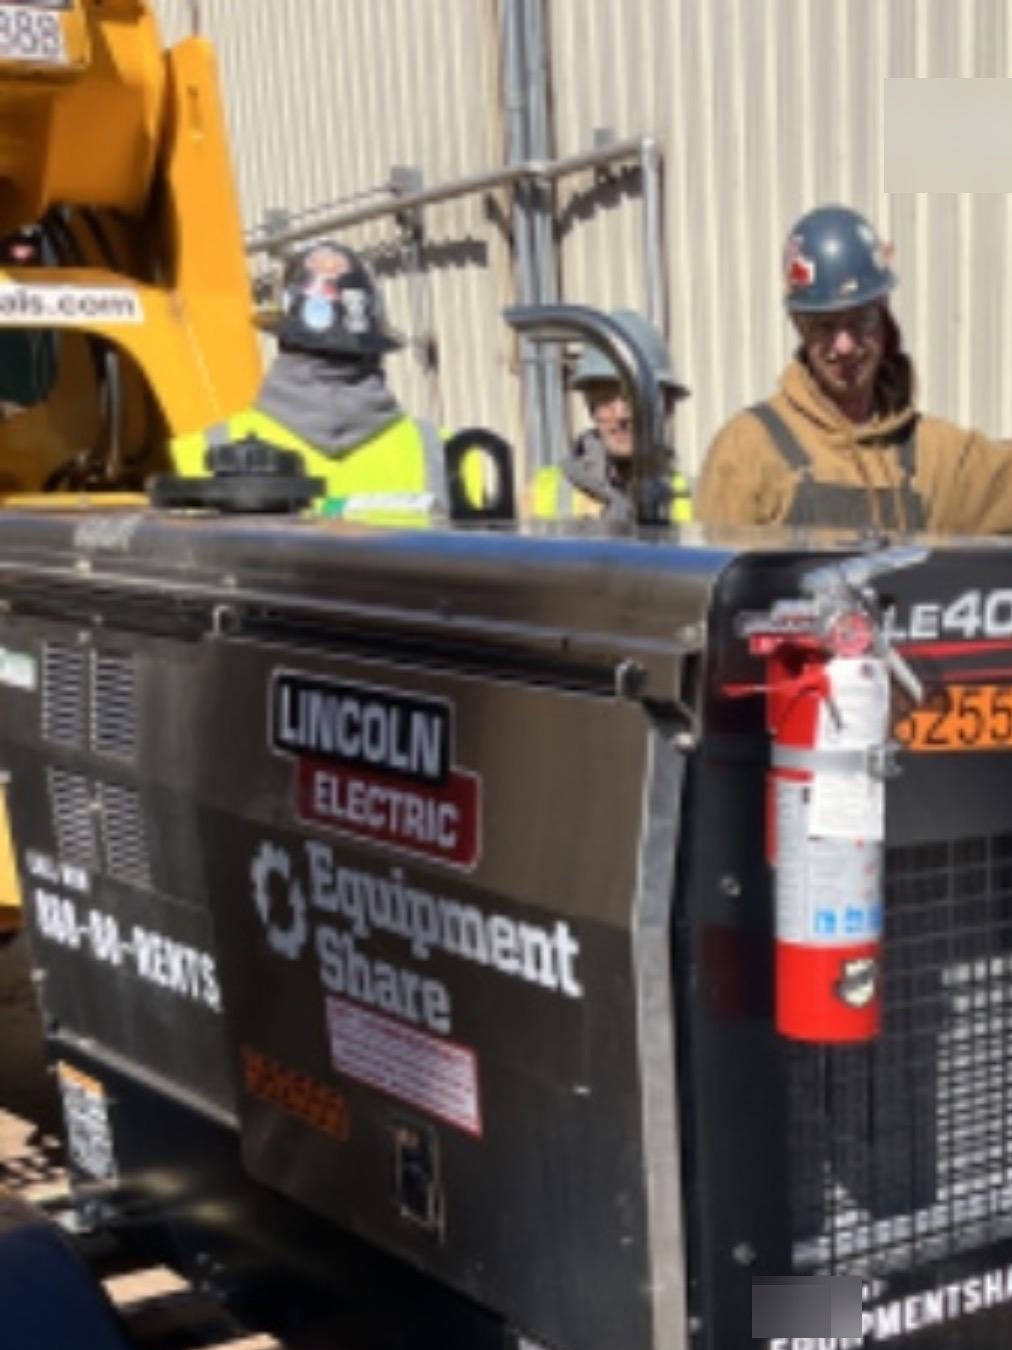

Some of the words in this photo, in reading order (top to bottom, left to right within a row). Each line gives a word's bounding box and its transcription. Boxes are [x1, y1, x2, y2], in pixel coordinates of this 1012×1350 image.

[278, 683, 443, 778] LINCOLN
[313, 770, 460, 848] ELECTRIC
[304, 839, 584, 998] Equipment
[314, 925, 452, 1034] Share
